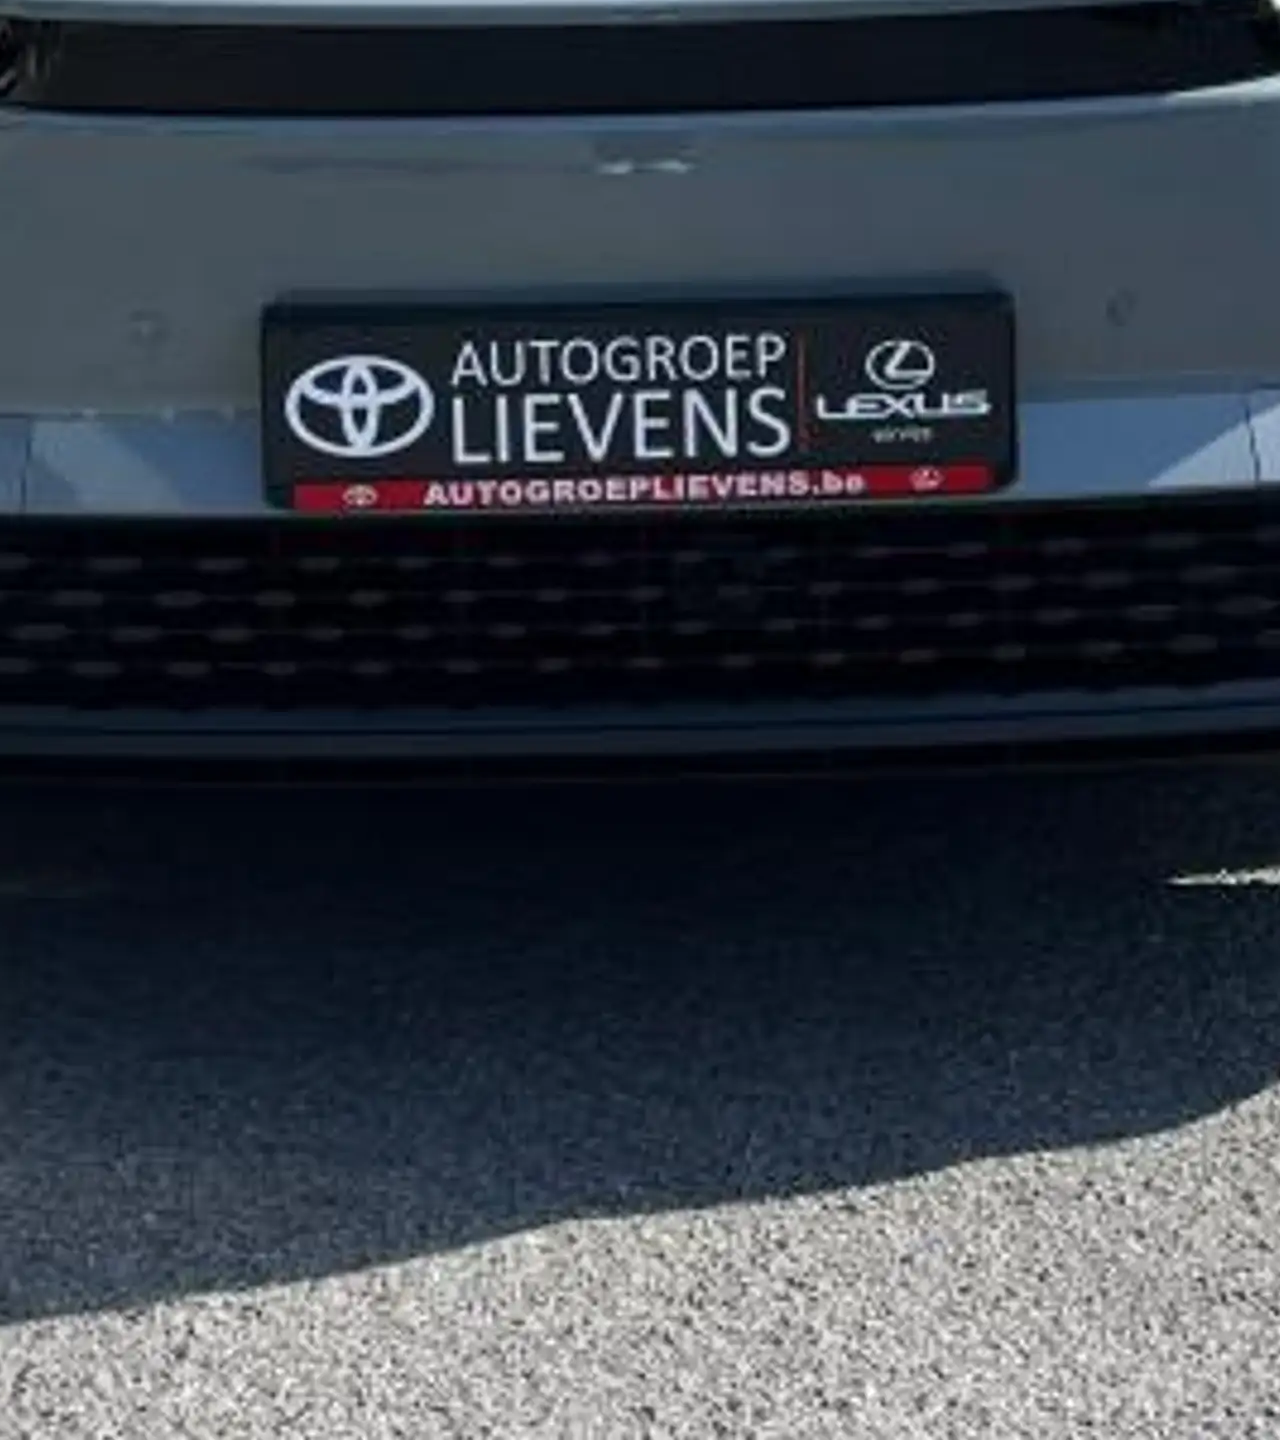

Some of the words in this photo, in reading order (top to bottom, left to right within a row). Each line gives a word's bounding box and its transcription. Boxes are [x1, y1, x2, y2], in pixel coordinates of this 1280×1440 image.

[450, 334, 788, 387] AUTOGROEP
[451, 387, 791, 465] LIEVENS
[817, 388, 991, 421] LEXUS
[424, 472, 865, 507] AUTOGROEPLIEVENS.be
